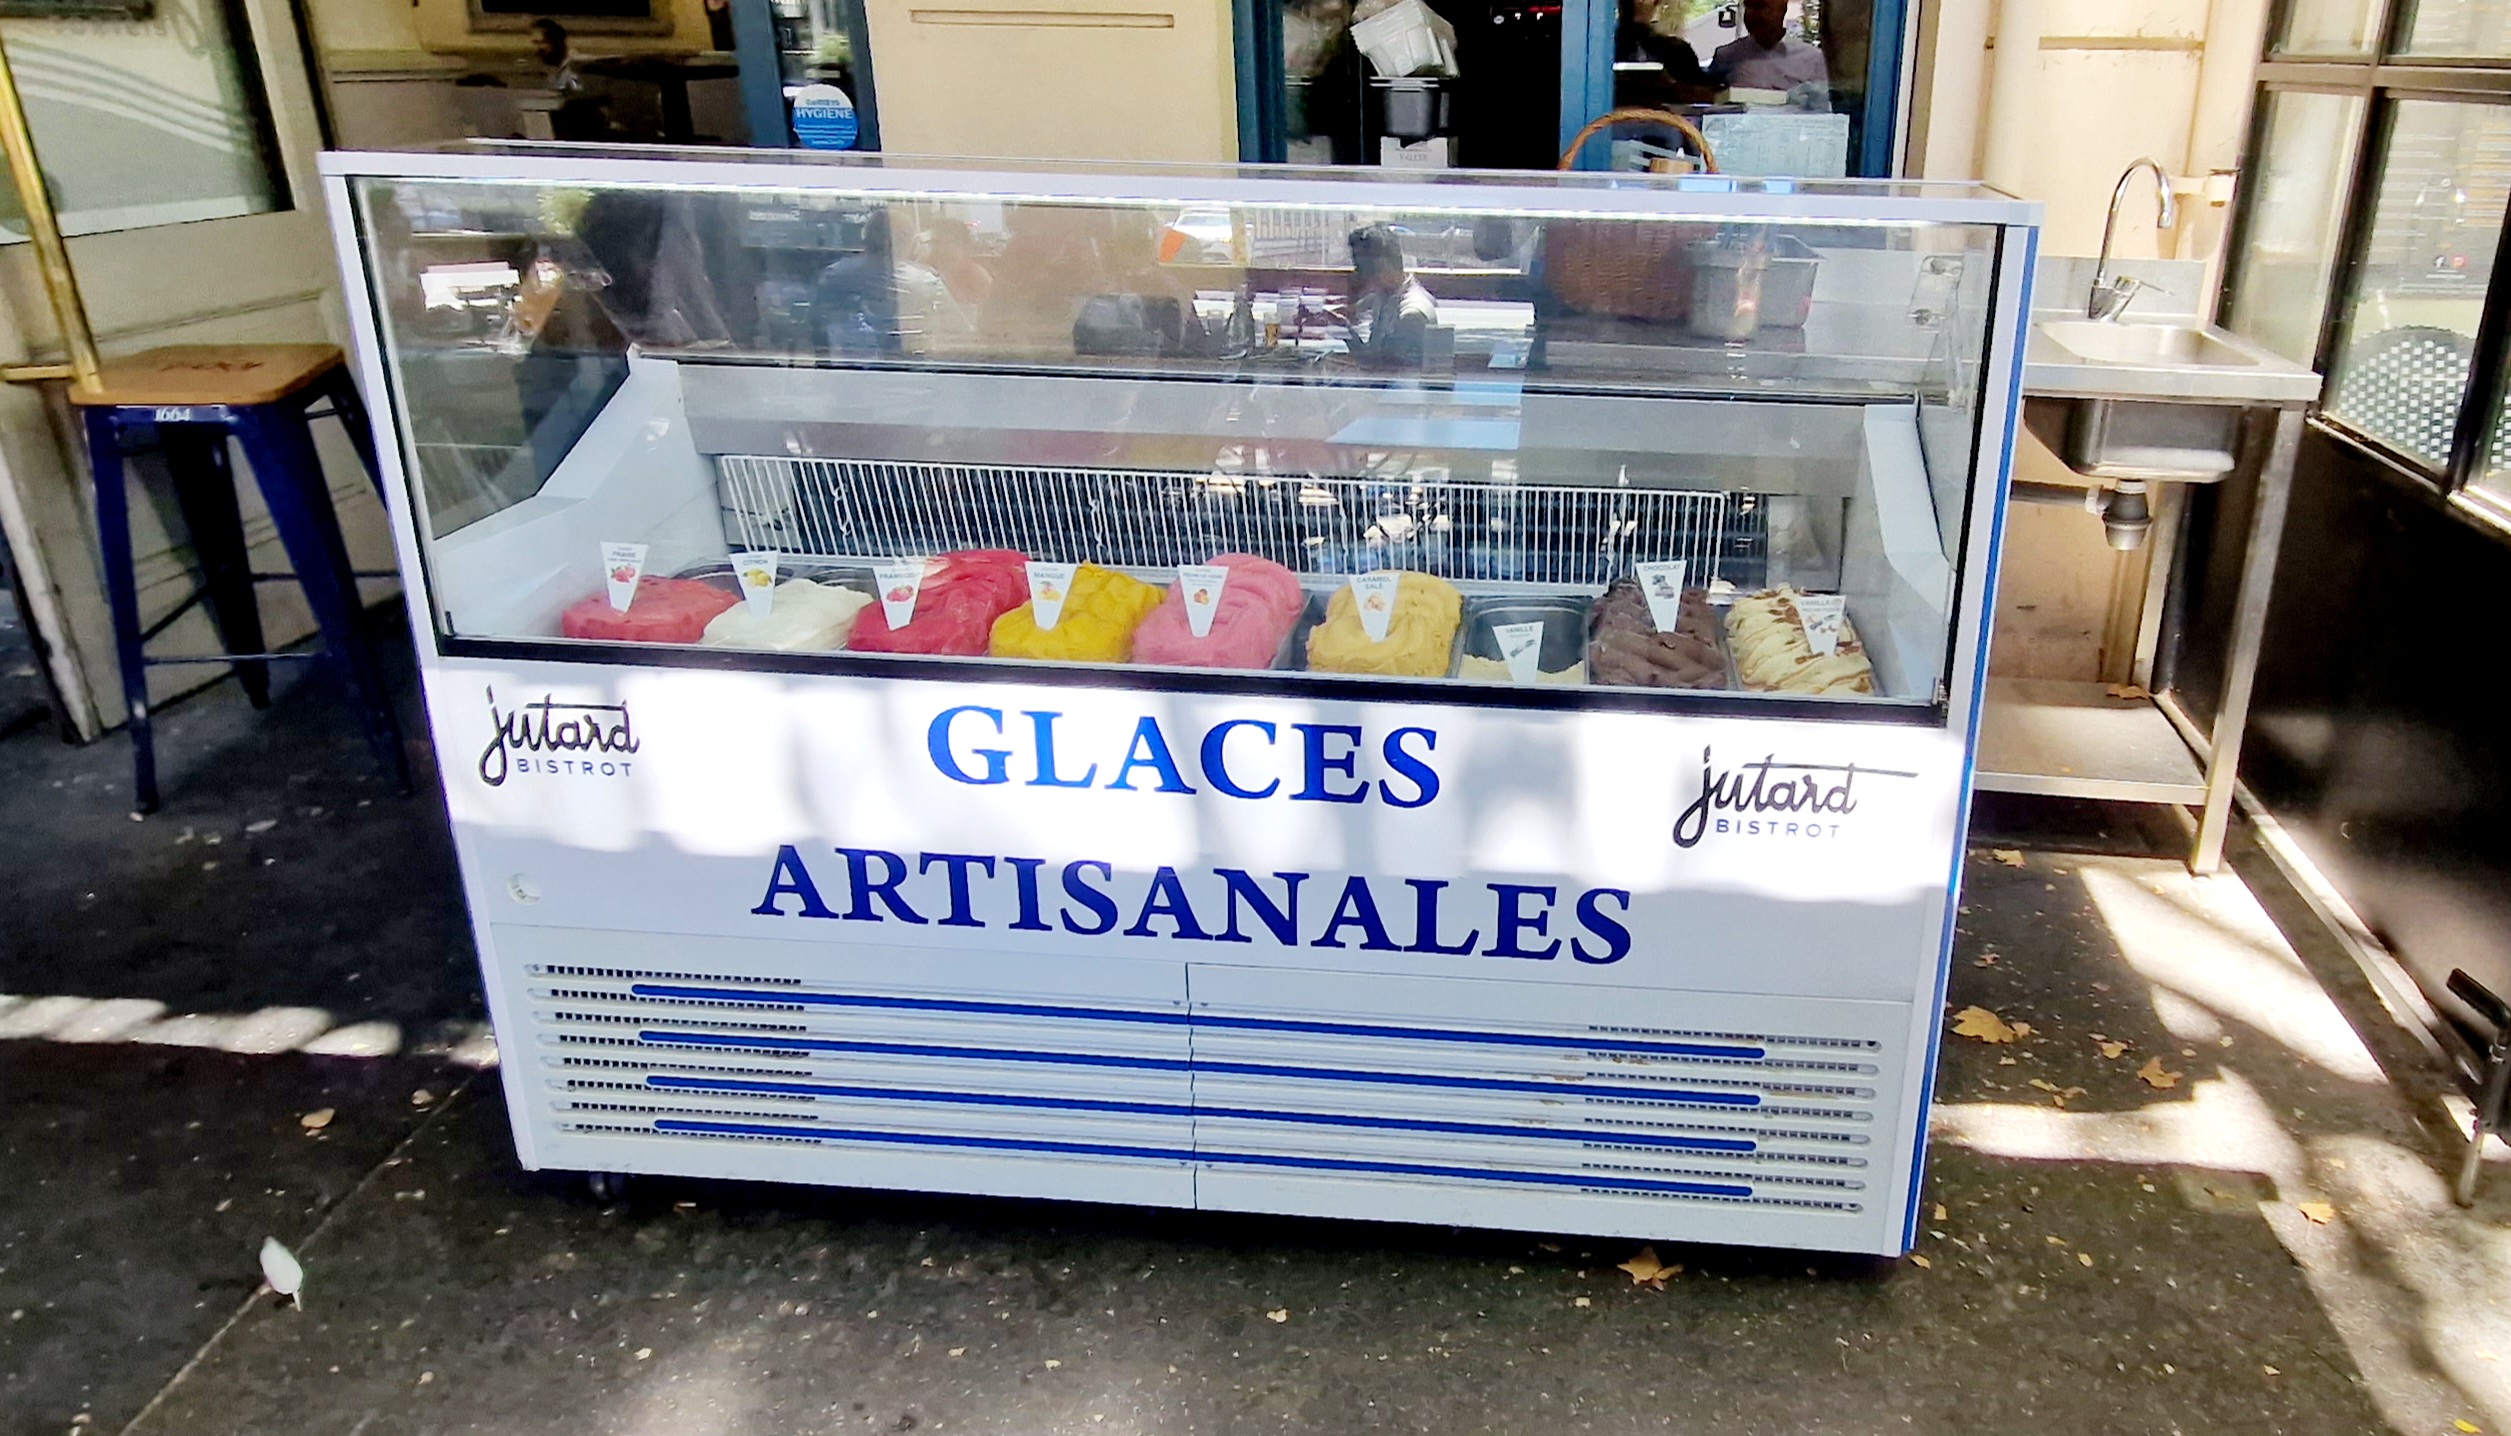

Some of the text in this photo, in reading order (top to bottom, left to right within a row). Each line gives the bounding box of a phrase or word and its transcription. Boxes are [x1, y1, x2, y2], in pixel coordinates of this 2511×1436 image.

[796, 108, 853, 119] HYGIENE
[154, 407, 191, 421] 1664
[1034, 572, 1065, 580] MANGUE
[1505, 625, 1534, 633] VANILLE
[479, 683, 641, 788] jutard
[927, 705, 1442, 808] GLACES
[516, 757, 633, 778] BISTROT
[1672, 743, 1919, 849] jutard
[1715, 818, 1841, 839] BISTROT
[751, 843, 1633, 966] ARTISANALES
